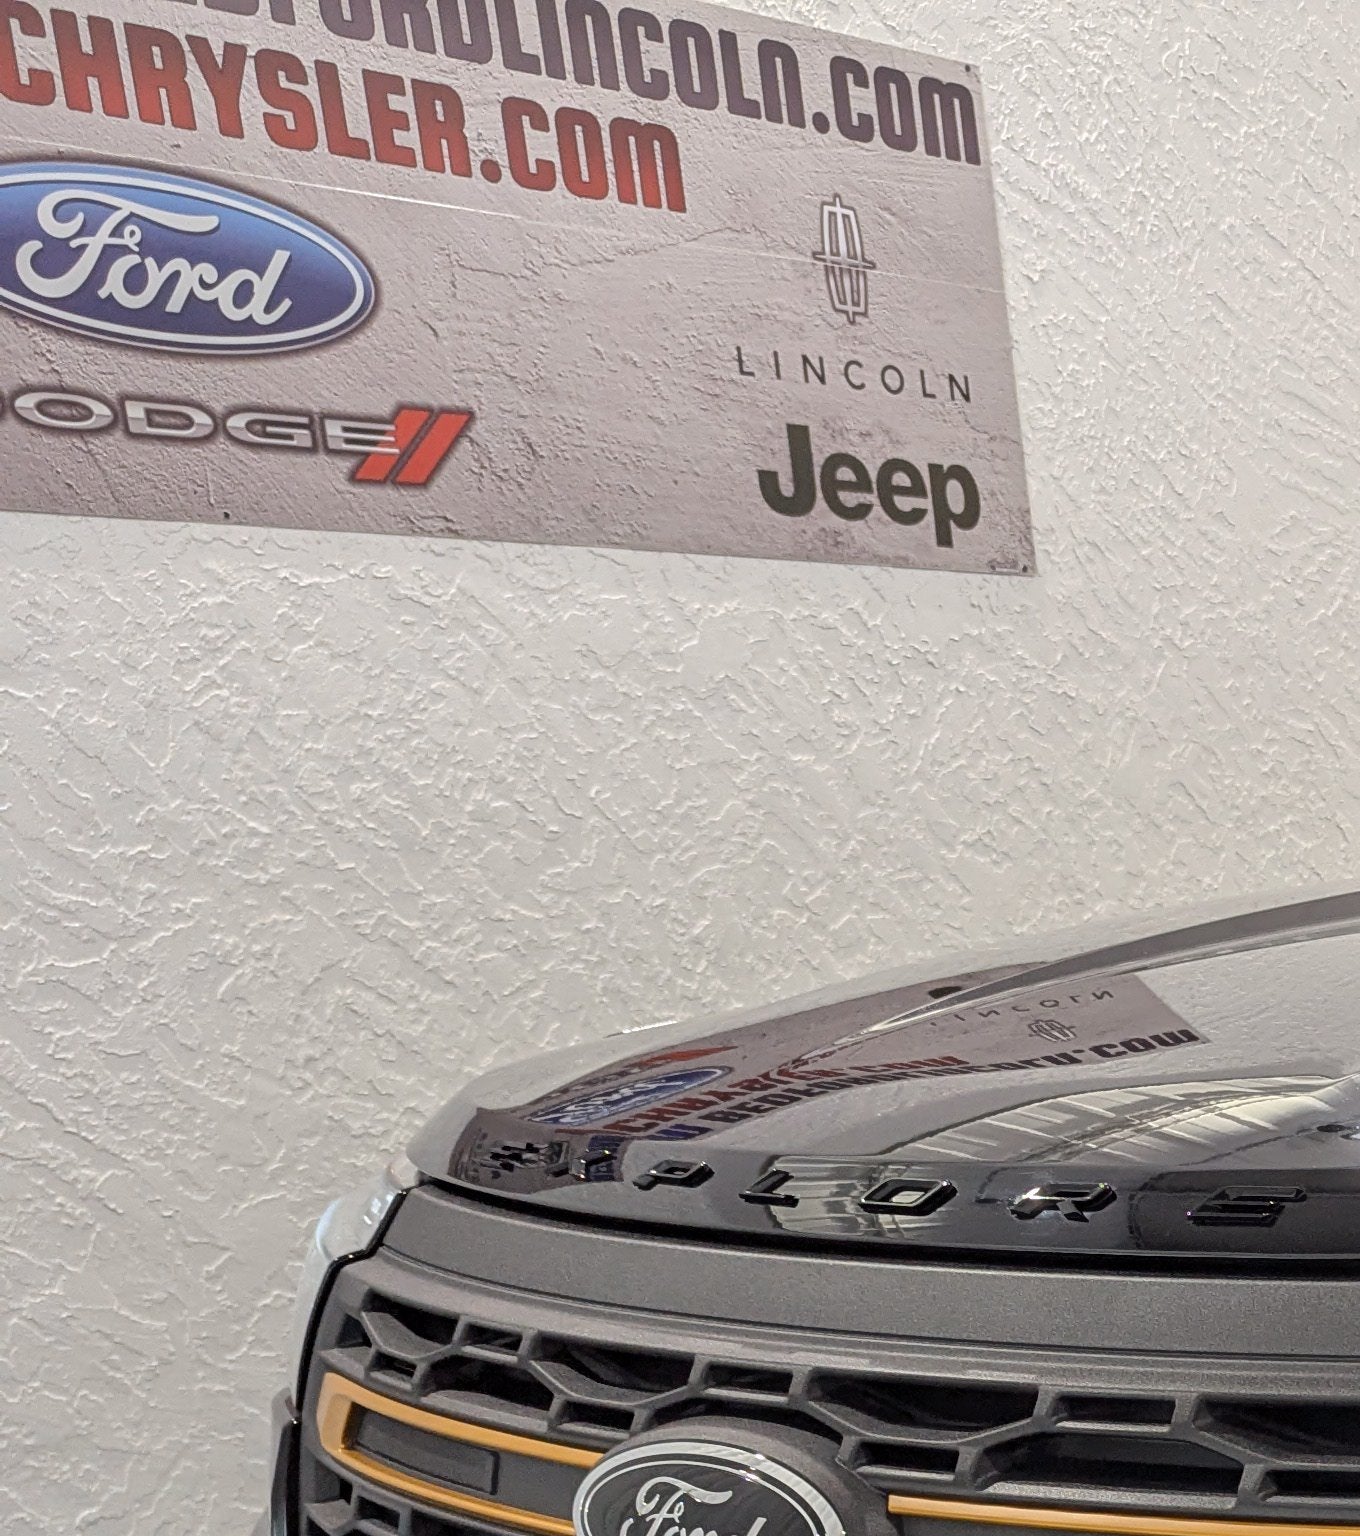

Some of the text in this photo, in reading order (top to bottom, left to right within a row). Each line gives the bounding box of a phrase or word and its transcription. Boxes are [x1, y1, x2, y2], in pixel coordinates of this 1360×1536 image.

[0, 0, 687, 213] CHRYSLER.COM
[15, 189, 292, 326] Ford
[0, 390, 400, 455] ODGE
[736, 345, 972, 403] LINCOLN
[757, 423, 982, 548] Jeep
